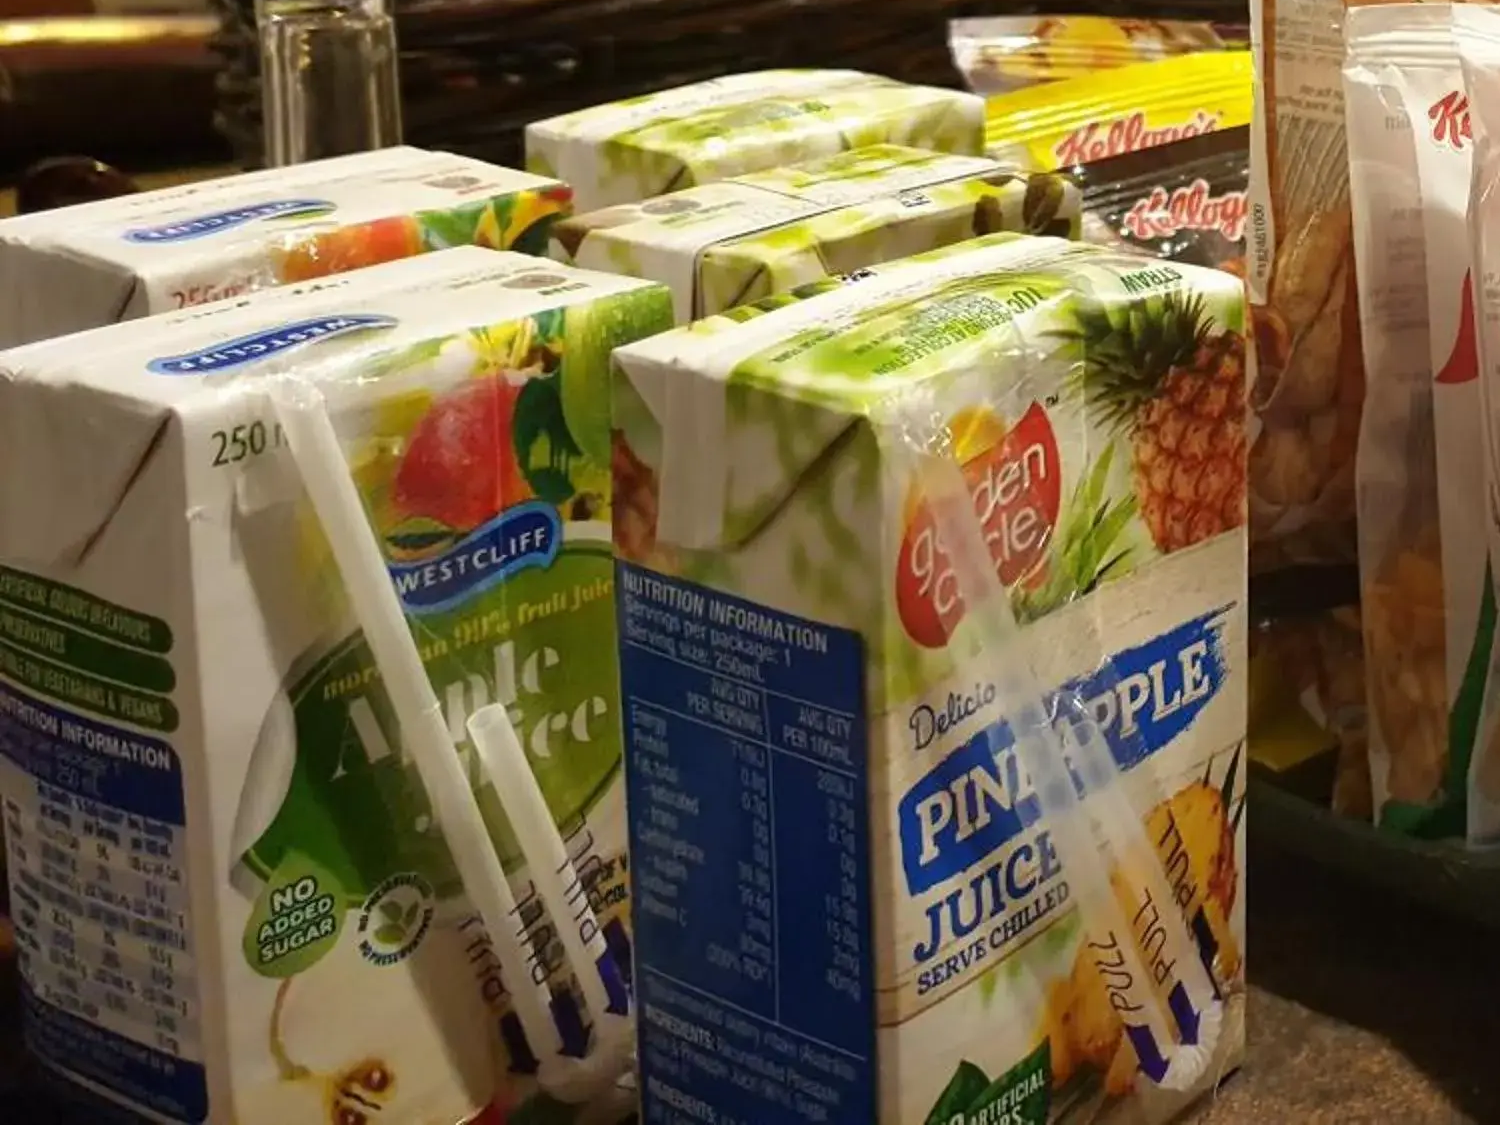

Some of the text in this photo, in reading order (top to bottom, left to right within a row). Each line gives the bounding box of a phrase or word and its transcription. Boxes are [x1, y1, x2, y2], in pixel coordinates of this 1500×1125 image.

[1124, 178, 1251, 242] Kellog
[1119, 266, 1184, 296] STRAW
[211, 420, 267, 468] 250
[911, 442, 1047, 598] gden
[396, 527, 548, 595] WESTCLIFF
[933, 507, 1039, 615] cle
[623, 570, 829, 654] NUTRITION INFORMATION
[61, 719, 171, 771] INFORMATION
[909, 684, 997, 751] Delicio
[915, 640, 1210, 866] PINPPLE
[1158, 810, 1197, 910] PULL
[259, 896, 333, 942] ADDED
[273, 877, 315, 913] NO
[913, 831, 1062, 963] JUICE
[261, 916, 334, 963] SUGAR
[917, 881, 1070, 996] SERVE CHILLED
[1133, 888, 1177, 987] PULL
[1088, 930, 1145, 1015] PULL
[970, 1068, 1046, 1125] ARTIFICIAL
